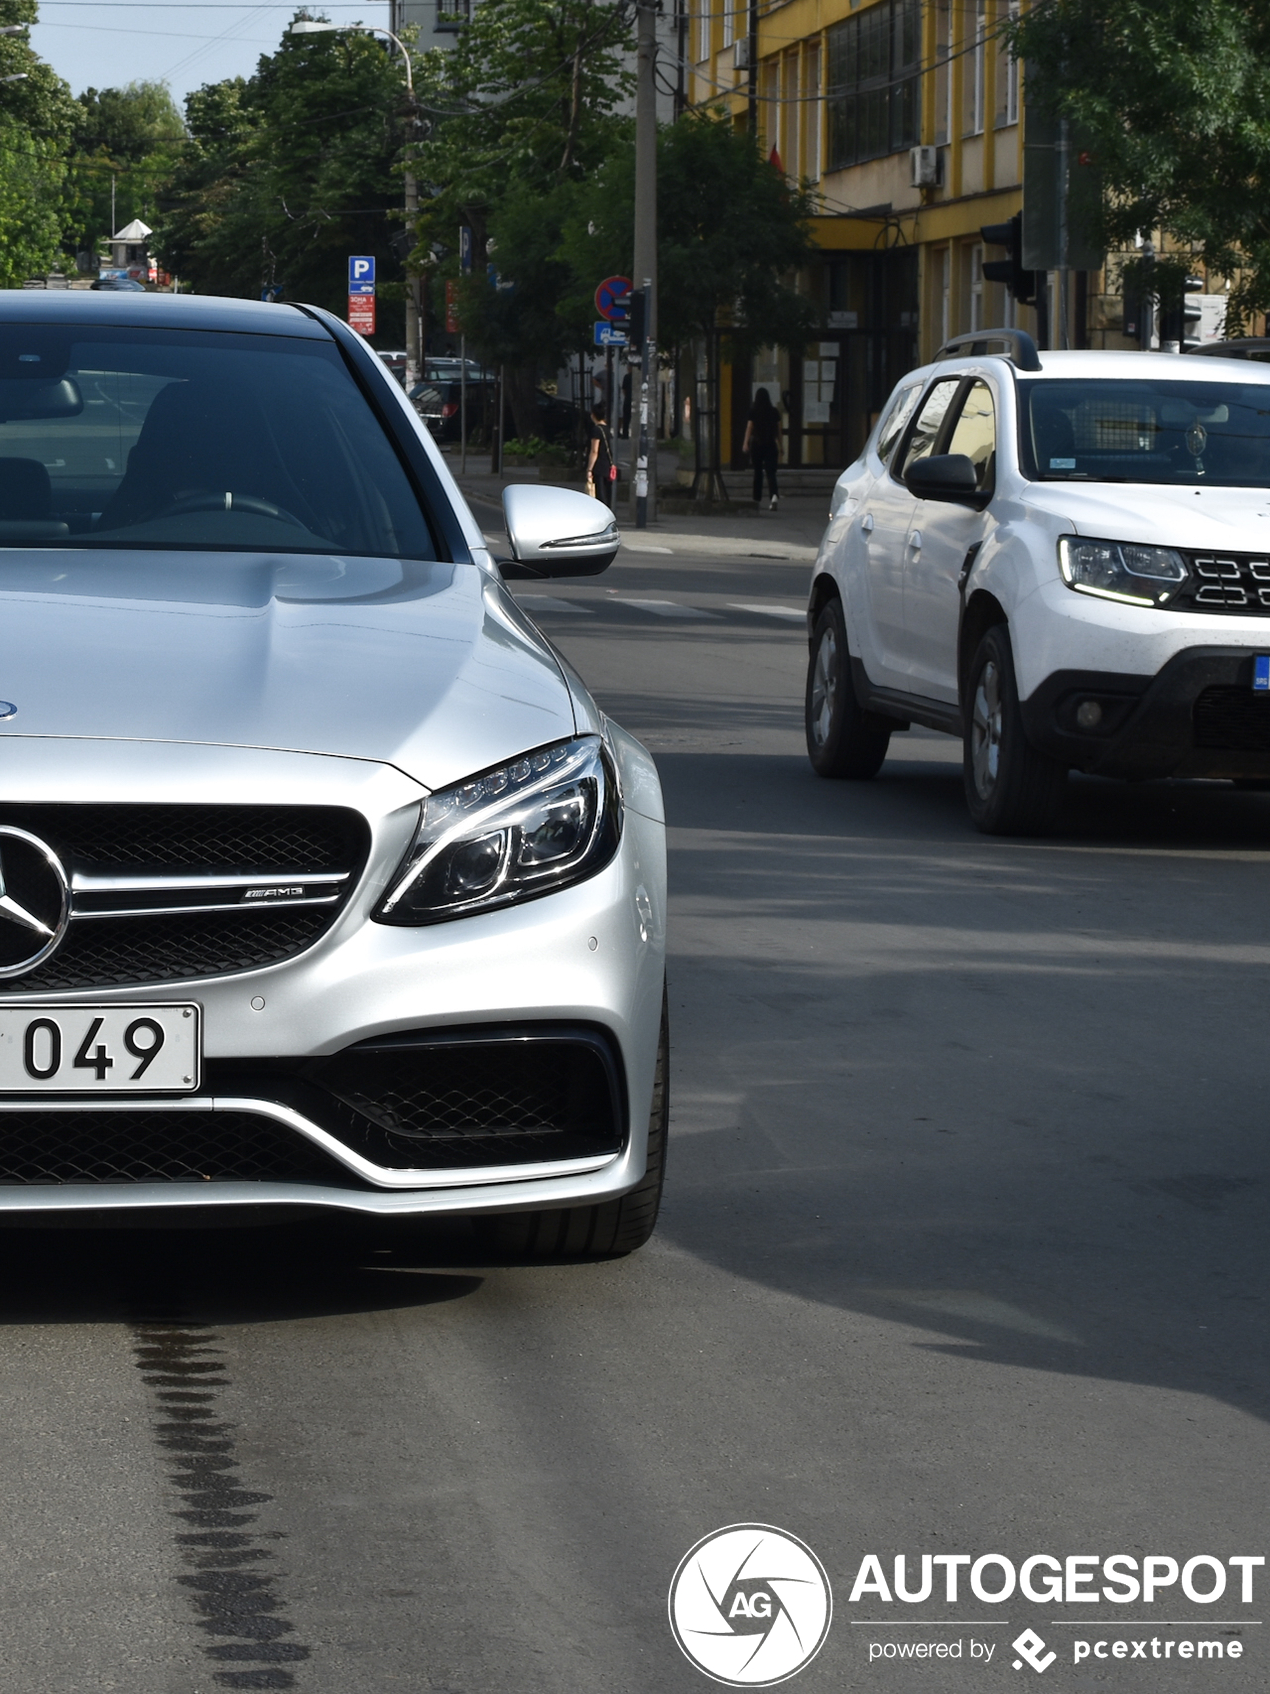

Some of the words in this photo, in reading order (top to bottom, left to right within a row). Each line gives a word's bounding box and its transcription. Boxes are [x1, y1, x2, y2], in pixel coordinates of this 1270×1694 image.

[354, 260, 370, 278] P
[264, 888, 303, 897] AMG
[24, 1016, 165, 1081] 049
